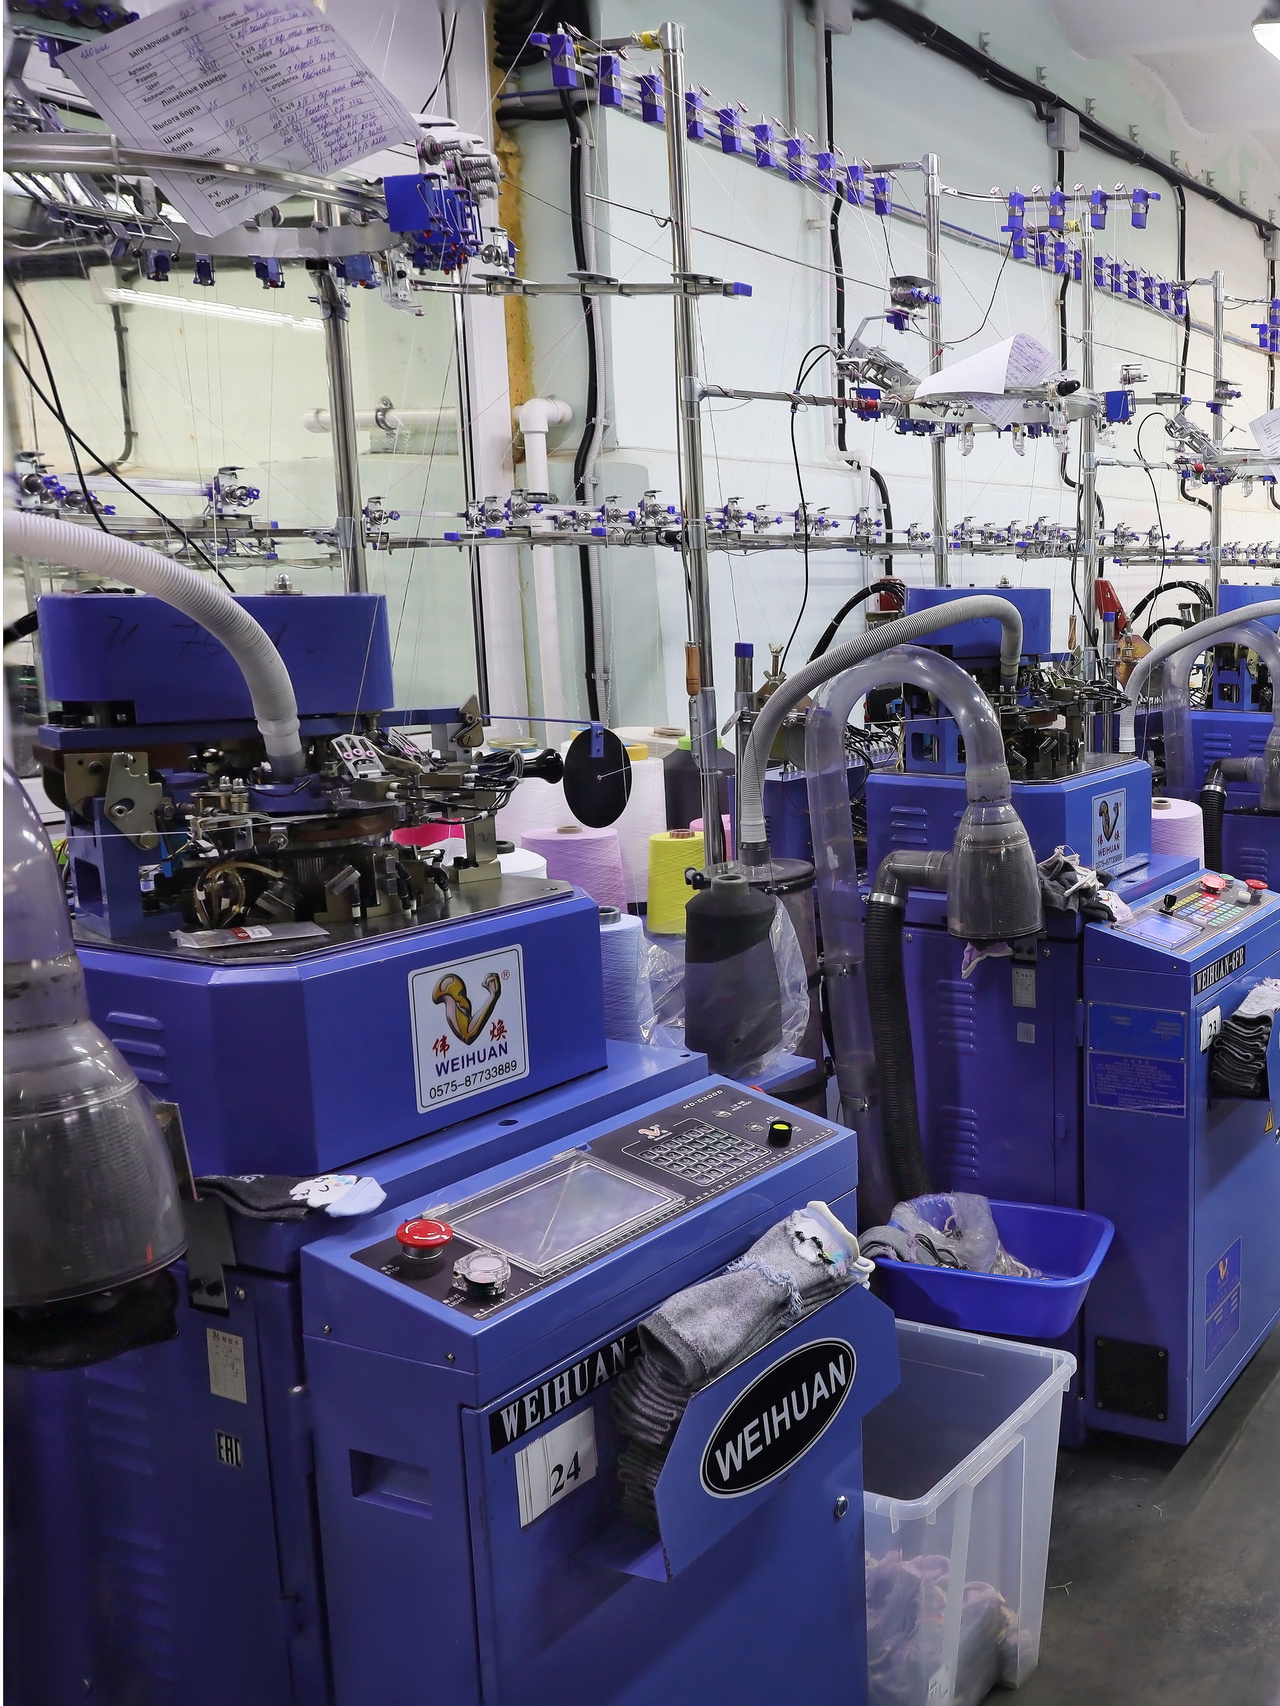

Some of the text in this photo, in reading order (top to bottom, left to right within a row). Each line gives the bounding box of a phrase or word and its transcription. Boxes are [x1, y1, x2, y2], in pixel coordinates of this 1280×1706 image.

[128, 34, 171, 59] ЗАПРАВОЧНАЯ
[128, 62, 152, 76] Артикул
[135, 71, 158, 84] Размер
[145, 81, 161, 91] Цвет
[161, 72, 228, 107] Линейные размеры
[271, 75, 299, 90] отработка
[142, 84, 176, 103] Количество
[152, 104, 201, 131] Высота борта
[163, 126, 195, 145] Ширина
[170, 140, 194, 153] борта
[196, 173, 217, 185] След
[215, 192, 240, 208] Форма
[1098, 842, 1120, 858] WEIHUAN
[435, 1041, 509, 1078] WEIHUAN
[429, 1059, 518, 1100] 0575-87733889
[714, 1354, 848, 1483] WEIHUAN
[550, 1450, 582, 1498] 24
